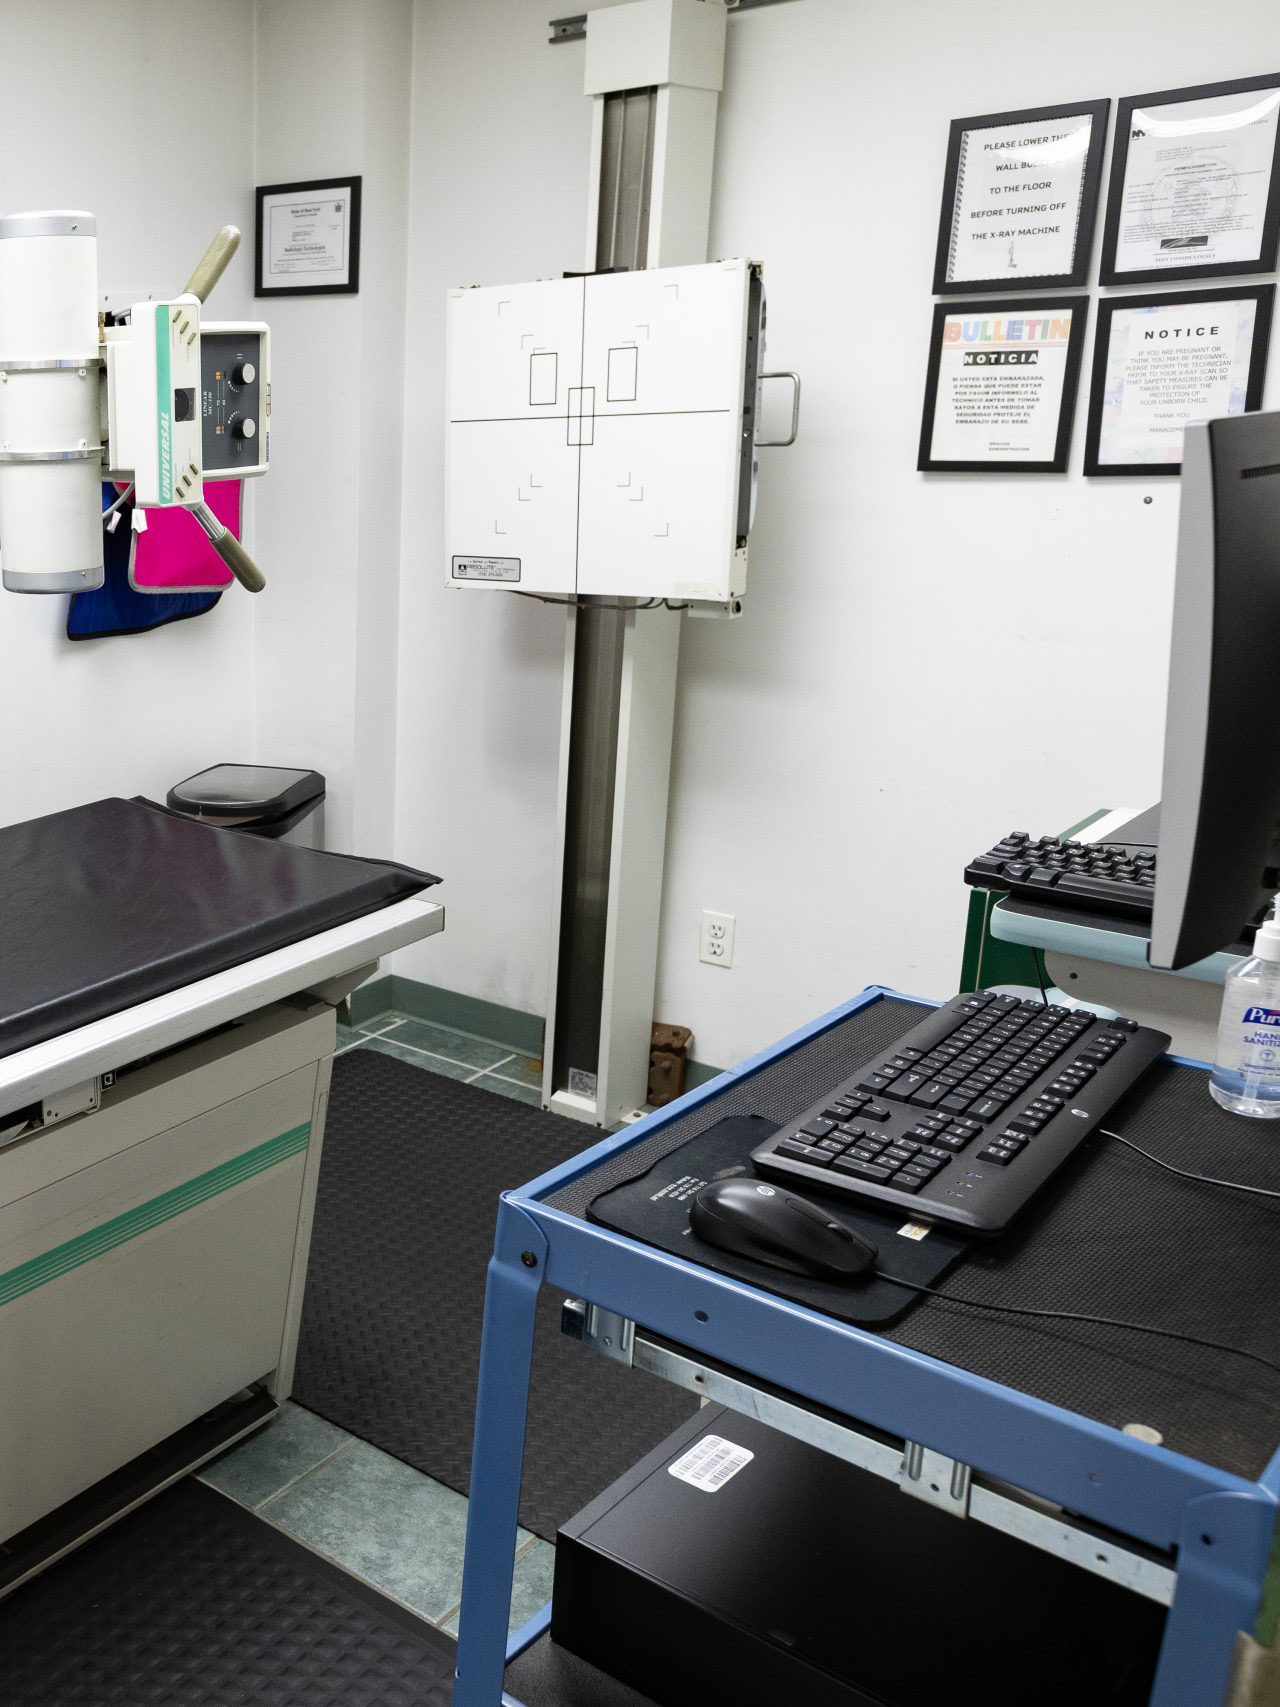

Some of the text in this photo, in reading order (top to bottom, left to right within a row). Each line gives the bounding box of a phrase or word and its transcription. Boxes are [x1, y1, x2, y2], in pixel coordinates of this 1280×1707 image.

[984, 141, 1016, 150] PLEASE
[1018, 136, 1048, 146] LOWER
[996, 163, 1019, 172] WALL
[1022, 182, 1052, 191] FLOOR
[971, 202, 1067, 218] BEFORE TURNING OFF
[990, 230, 1016, 238] X-RAY
[1018, 226, 1060, 235] MACHINE
[943, 319, 1072, 342] BULLETIN
[1145, 326, 1219, 339] NOTICE
[964, 353, 1038, 365] NOTICIA
[160, 410, 170, 500] UNIVERSAL
[1249, 1008, 1280, 1024] Pur
[1254, 1031, 1280, 1040] HAN
